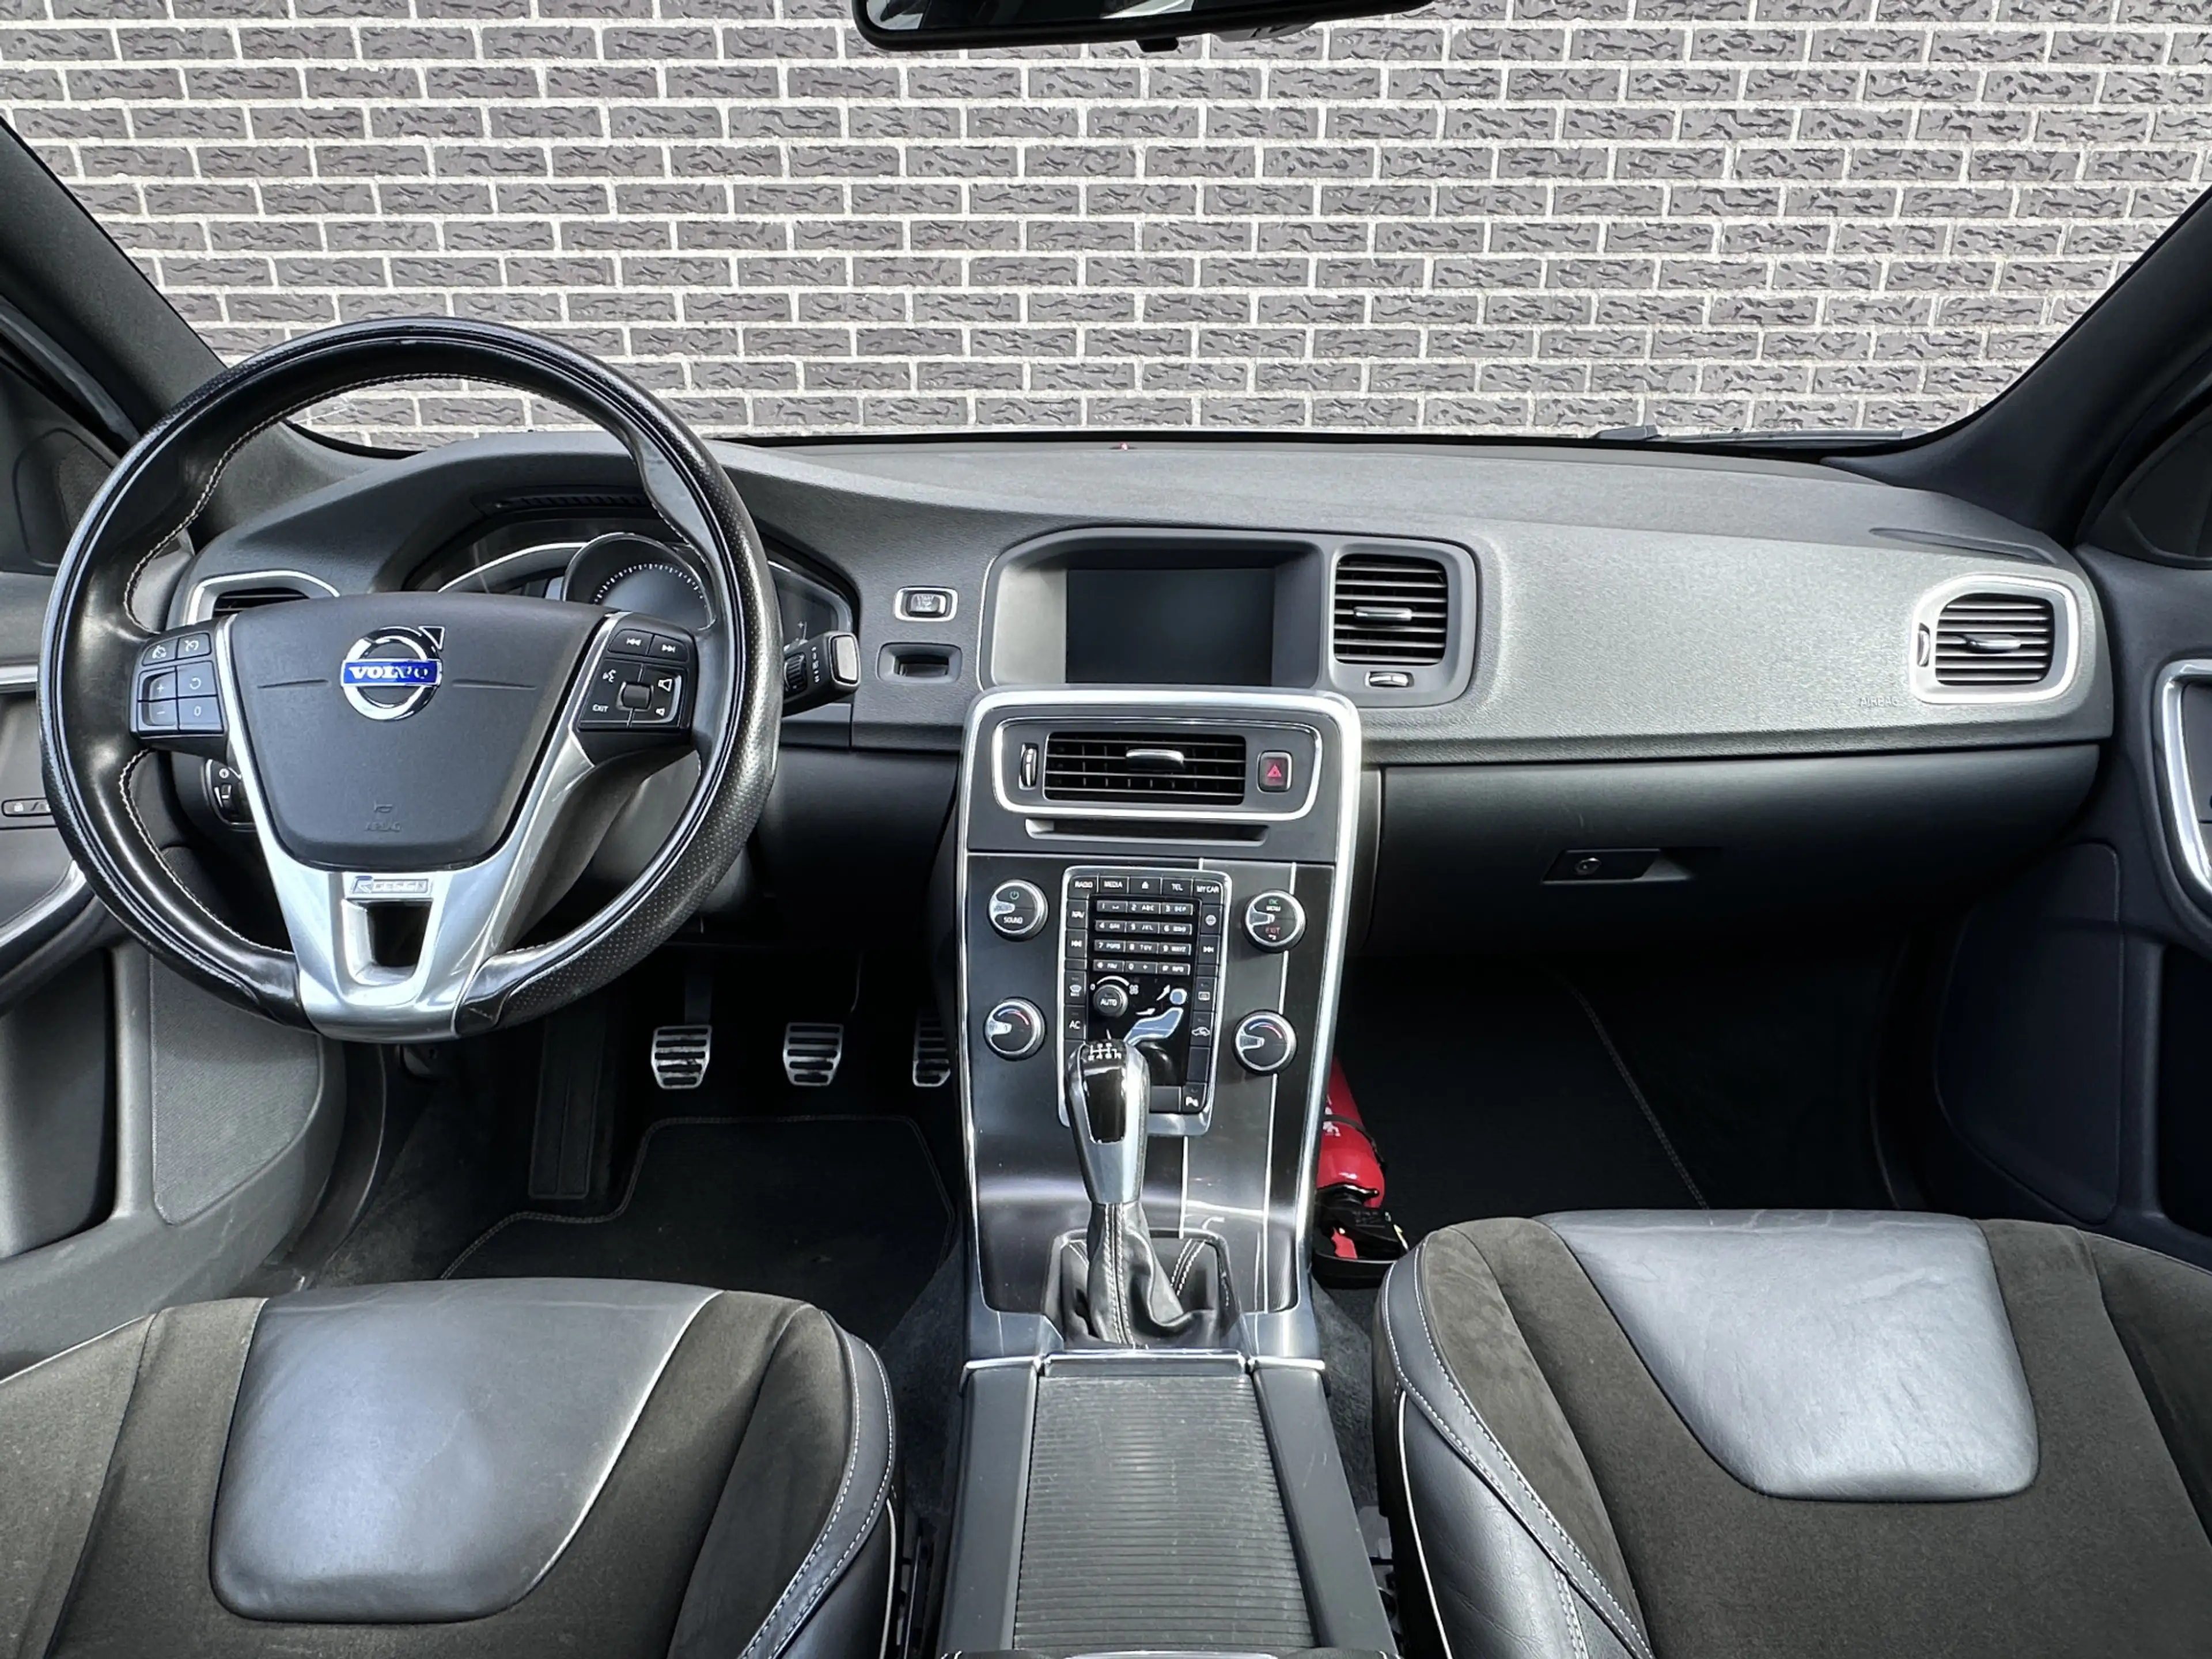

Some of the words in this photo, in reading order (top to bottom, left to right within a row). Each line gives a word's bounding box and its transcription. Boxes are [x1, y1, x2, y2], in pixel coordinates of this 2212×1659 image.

[348, 665, 429, 680] VOLVO
[1858, 695, 1899, 708] AIRBAG
[592, 703, 609, 713] EXIT
[1074, 880, 1093, 888] RADIO
[1104, 880, 1123, 888] MEDIA
[1172, 883, 1183, 891] TEL
[1131, 903, 1137, 911] 2
[1071, 911, 1085, 919] NAV
[1003, 916, 1023, 925] SOUND
[1131, 923, 1136, 931] 5
[1100, 997, 1118, 1007] AUTO
[1069, 1020, 1081, 1030] AC
